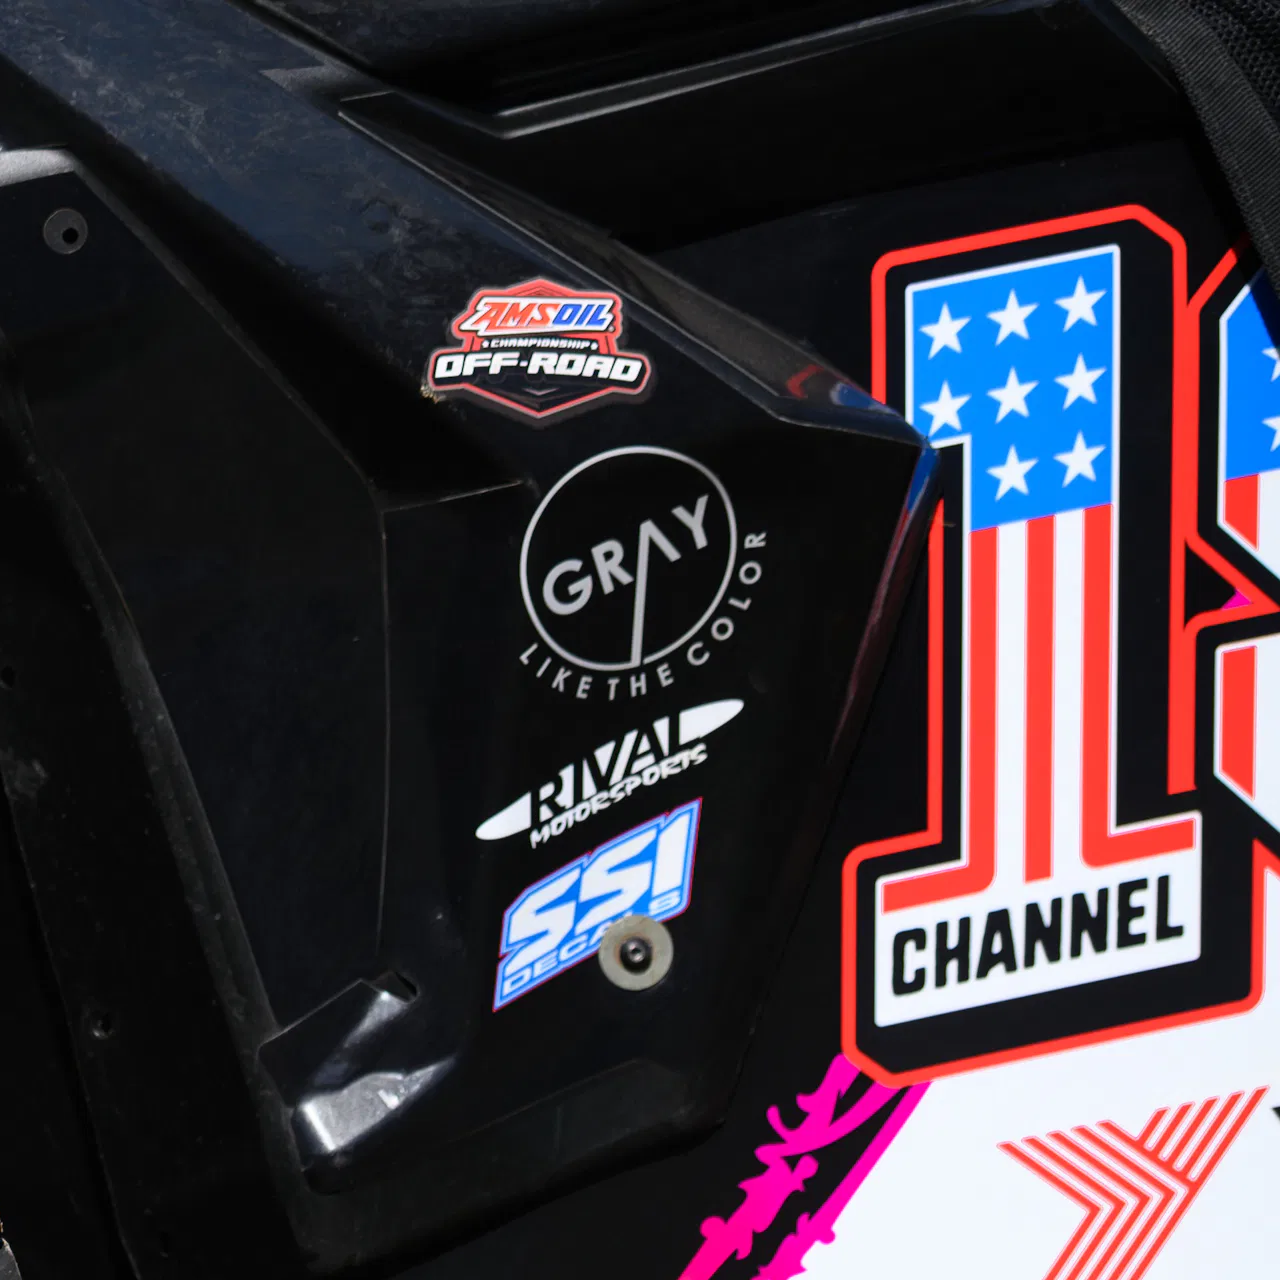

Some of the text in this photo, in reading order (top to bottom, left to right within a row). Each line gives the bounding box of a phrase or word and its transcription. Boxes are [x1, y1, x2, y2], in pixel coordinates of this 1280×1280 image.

[434, 351, 643, 383] OFF-ROAD
[470, 301, 608, 331] AMSOIL
[490, 337, 591, 350] CHAMPIONSHIP
[519, 530, 768, 701] LIKE THE COLOR
[542, 495, 710, 666] GRAY
[520, 706, 706, 834] RIVAL
[529, 743, 708, 849] MOTORSPORTS
[503, 813, 691, 978] SSI
[890, 873, 1185, 997] CHANNEL
